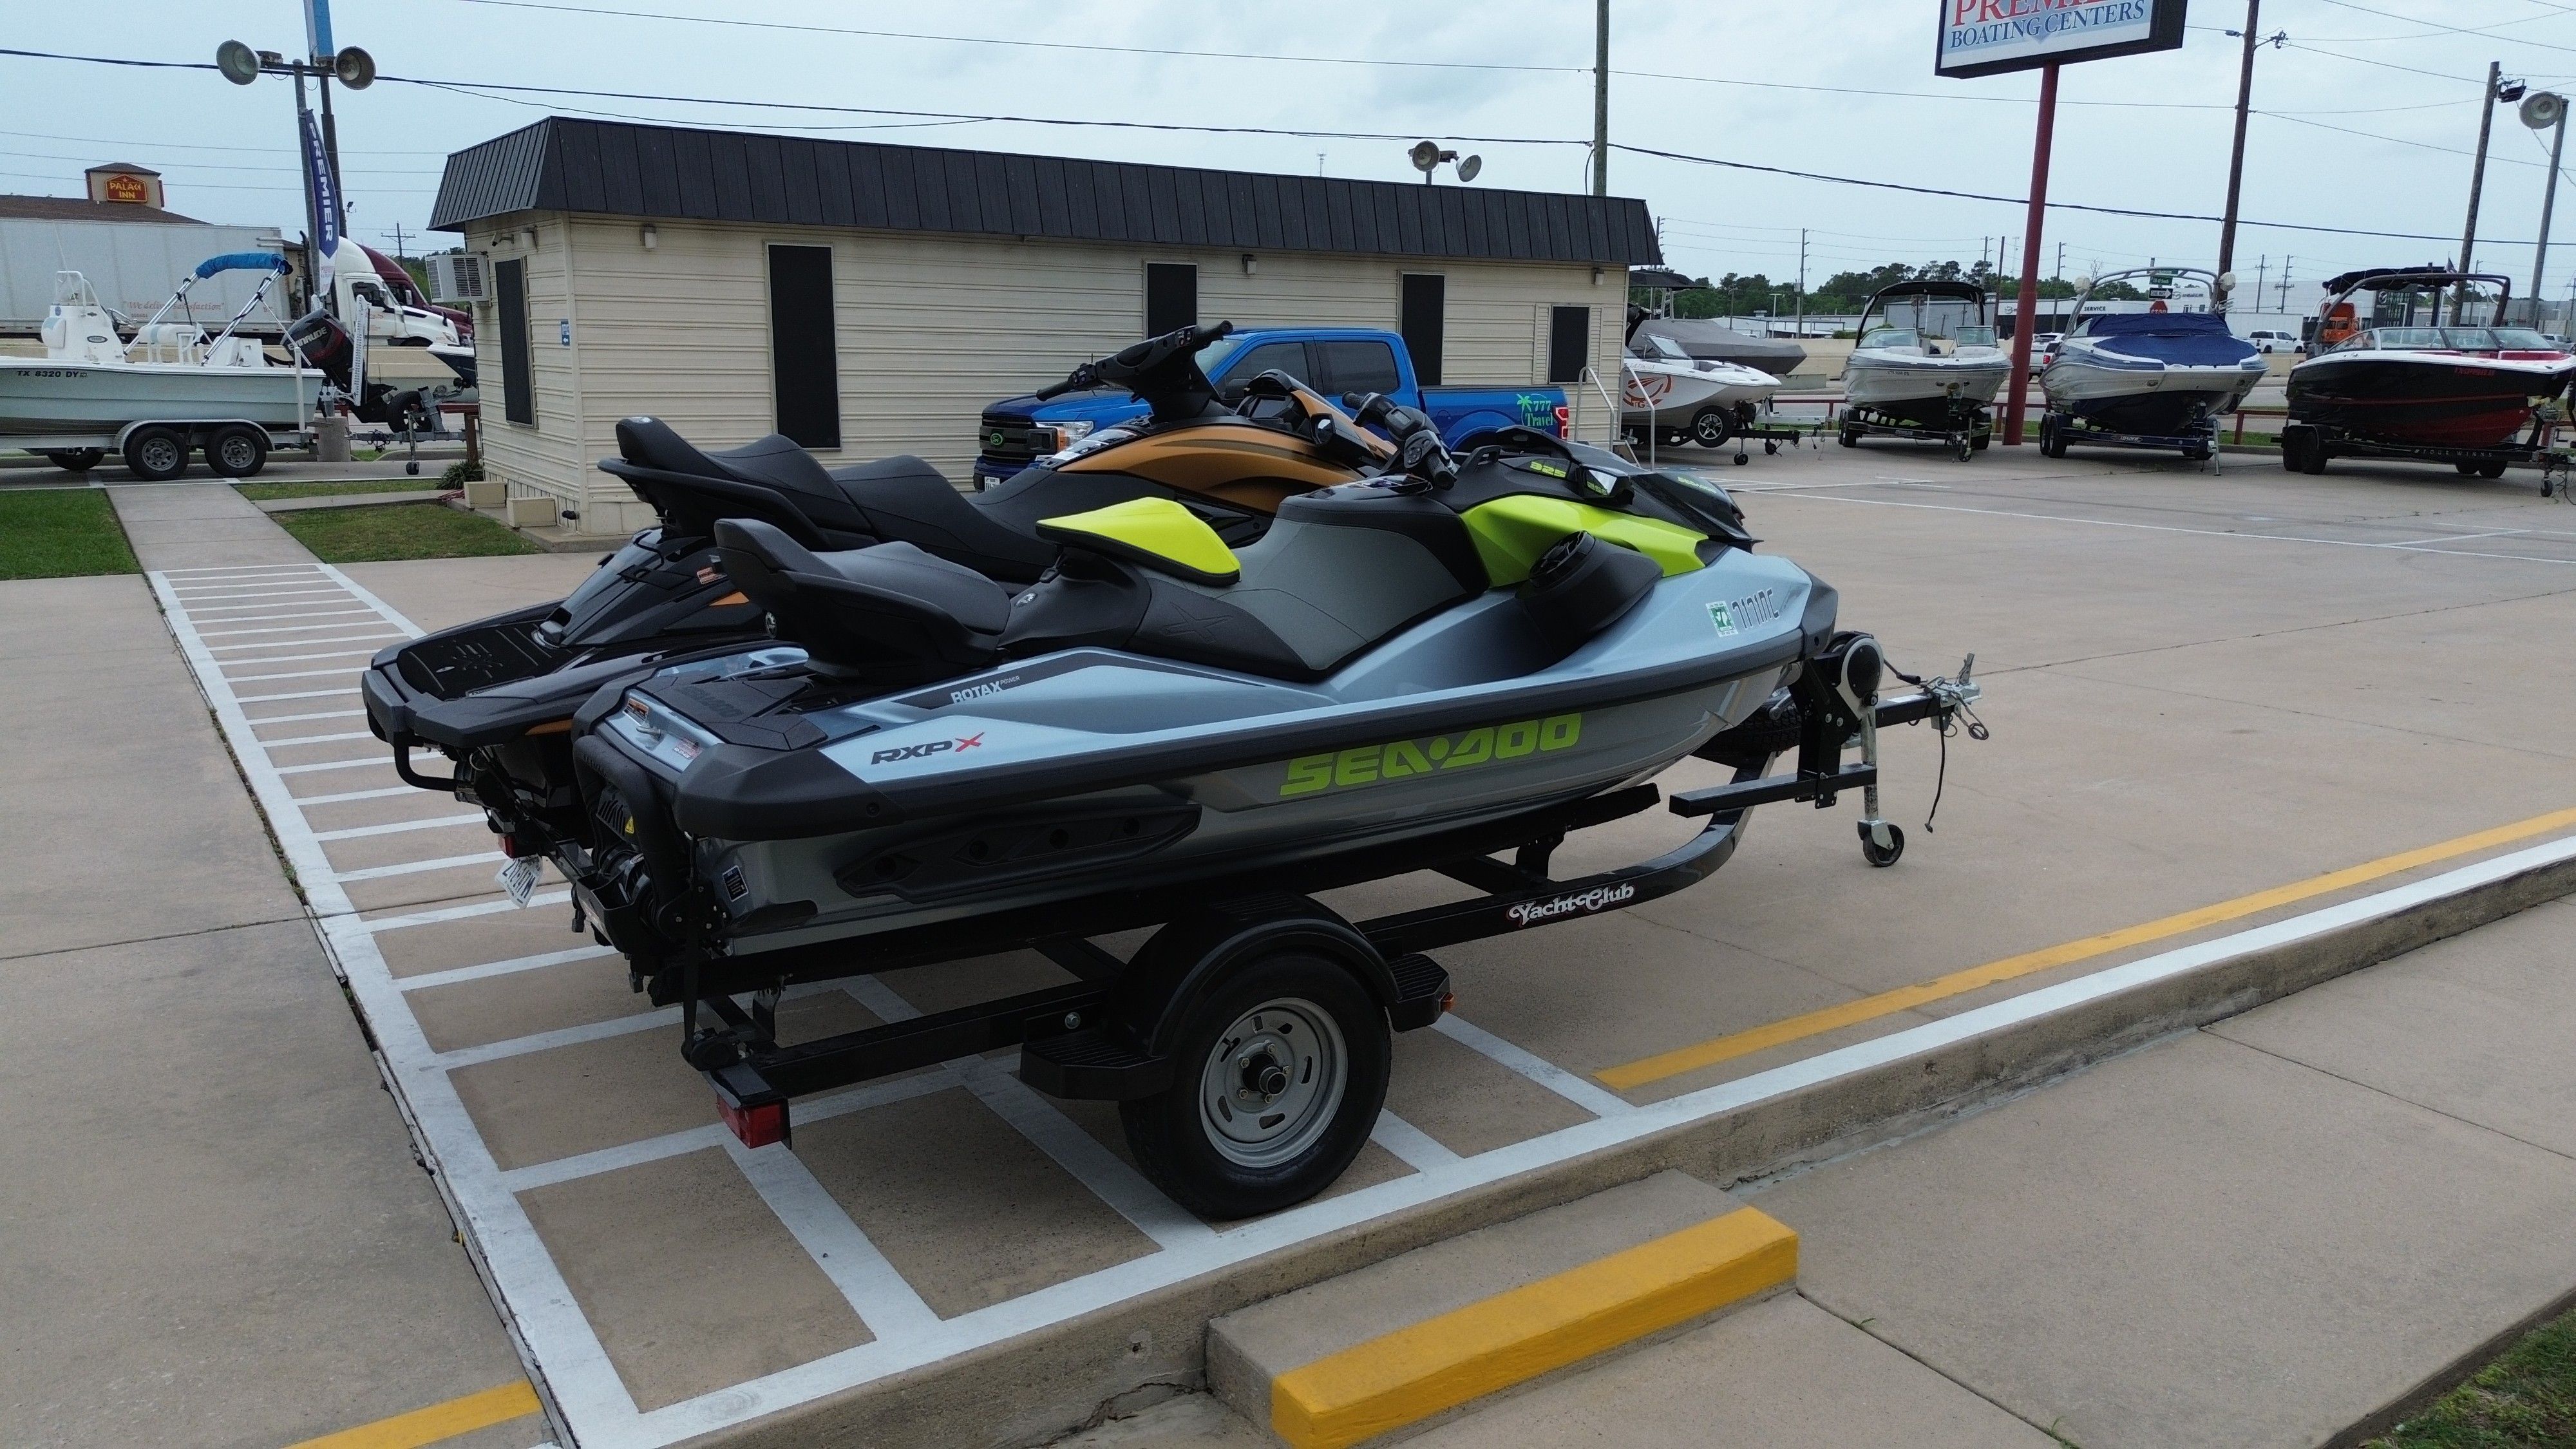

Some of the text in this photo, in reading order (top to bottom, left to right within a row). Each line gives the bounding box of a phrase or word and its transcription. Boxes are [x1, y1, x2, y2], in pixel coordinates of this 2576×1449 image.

[1951, 0, 2132, 48] BOATING CENTERS
[308, 122, 334, 242] PREMIER
[119, 191, 135, 199] INN
[1525, 412, 1553, 426] Travel
[1533, 401, 1552, 412] 777
[1530, 461, 1566, 478] 325
[951, 676, 1021, 705] ROTAX POWER
[871, 740, 953, 765] RXP
[1508, 882, 1635, 925] Yacht Club
